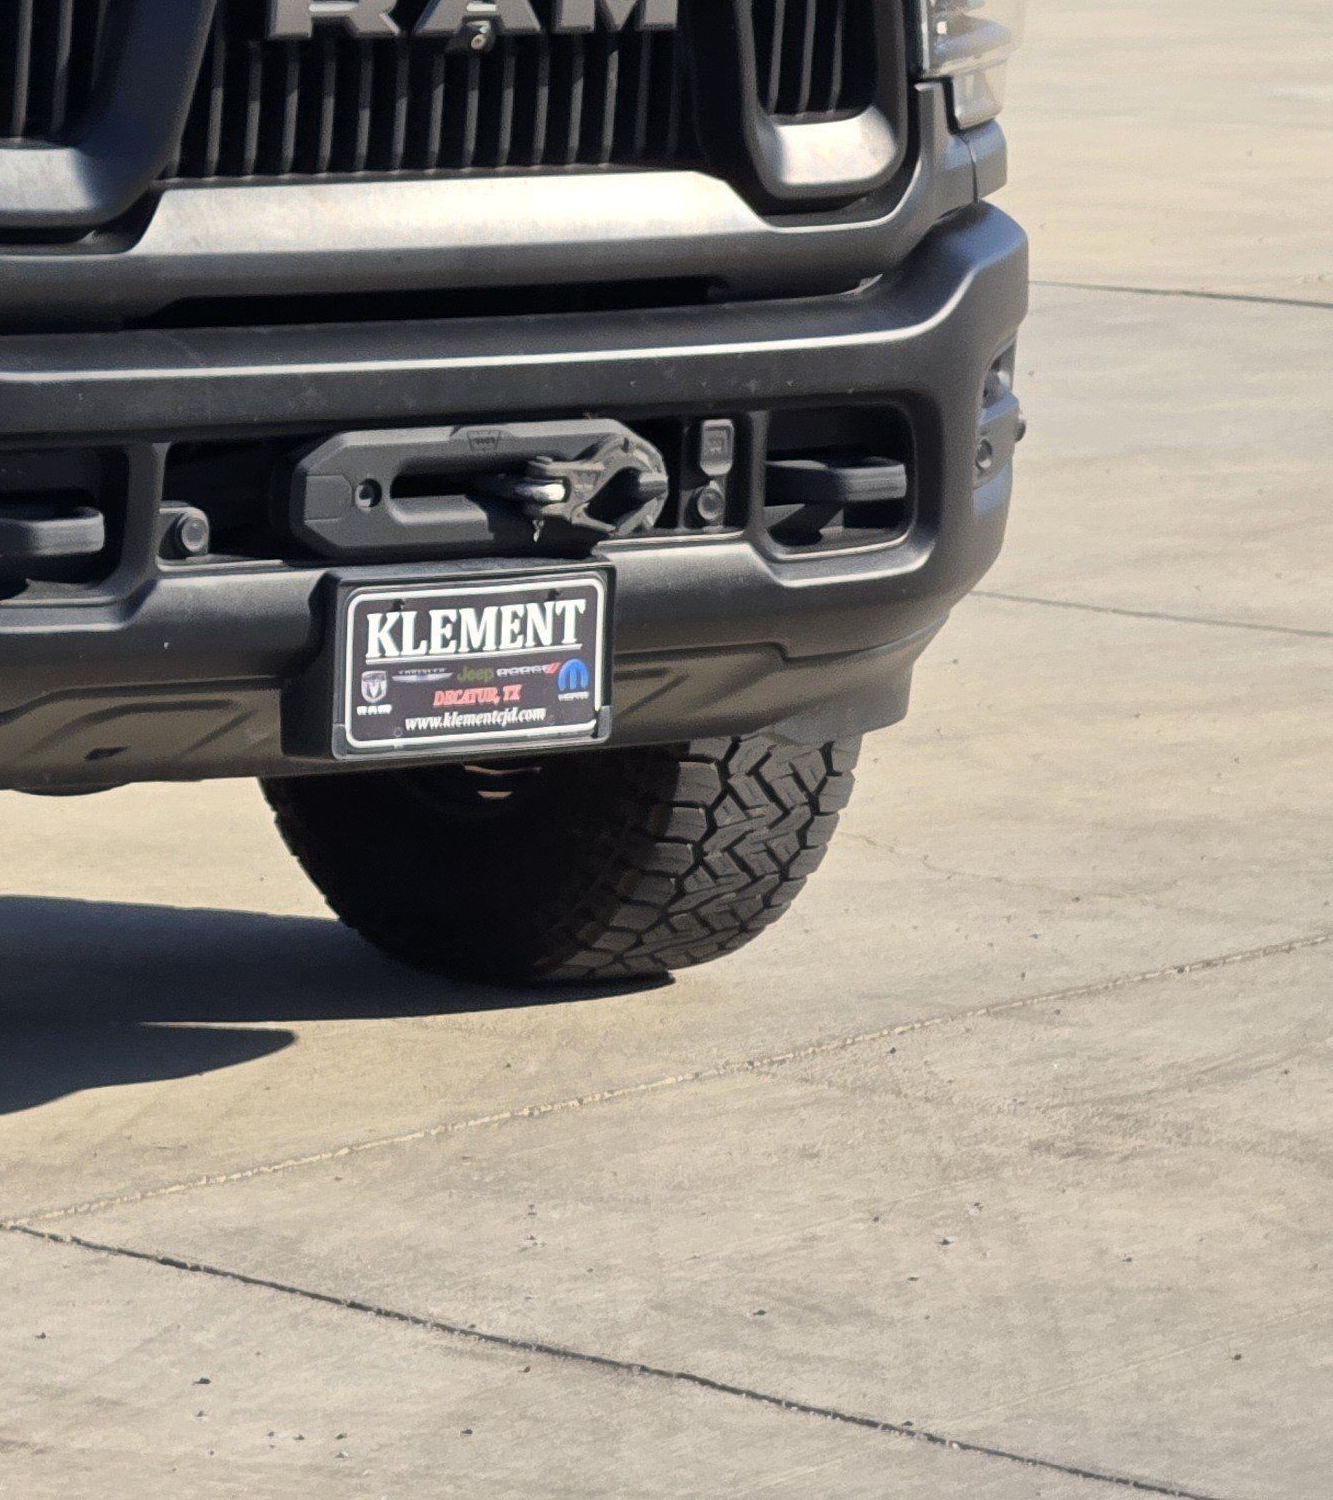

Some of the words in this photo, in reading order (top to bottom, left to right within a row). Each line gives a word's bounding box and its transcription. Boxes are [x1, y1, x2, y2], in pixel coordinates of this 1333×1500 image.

[365, 599, 586, 658] KLEMENT
[502, 684, 523, 702] TX
[405, 706, 547, 732] www.klementcjd.com
